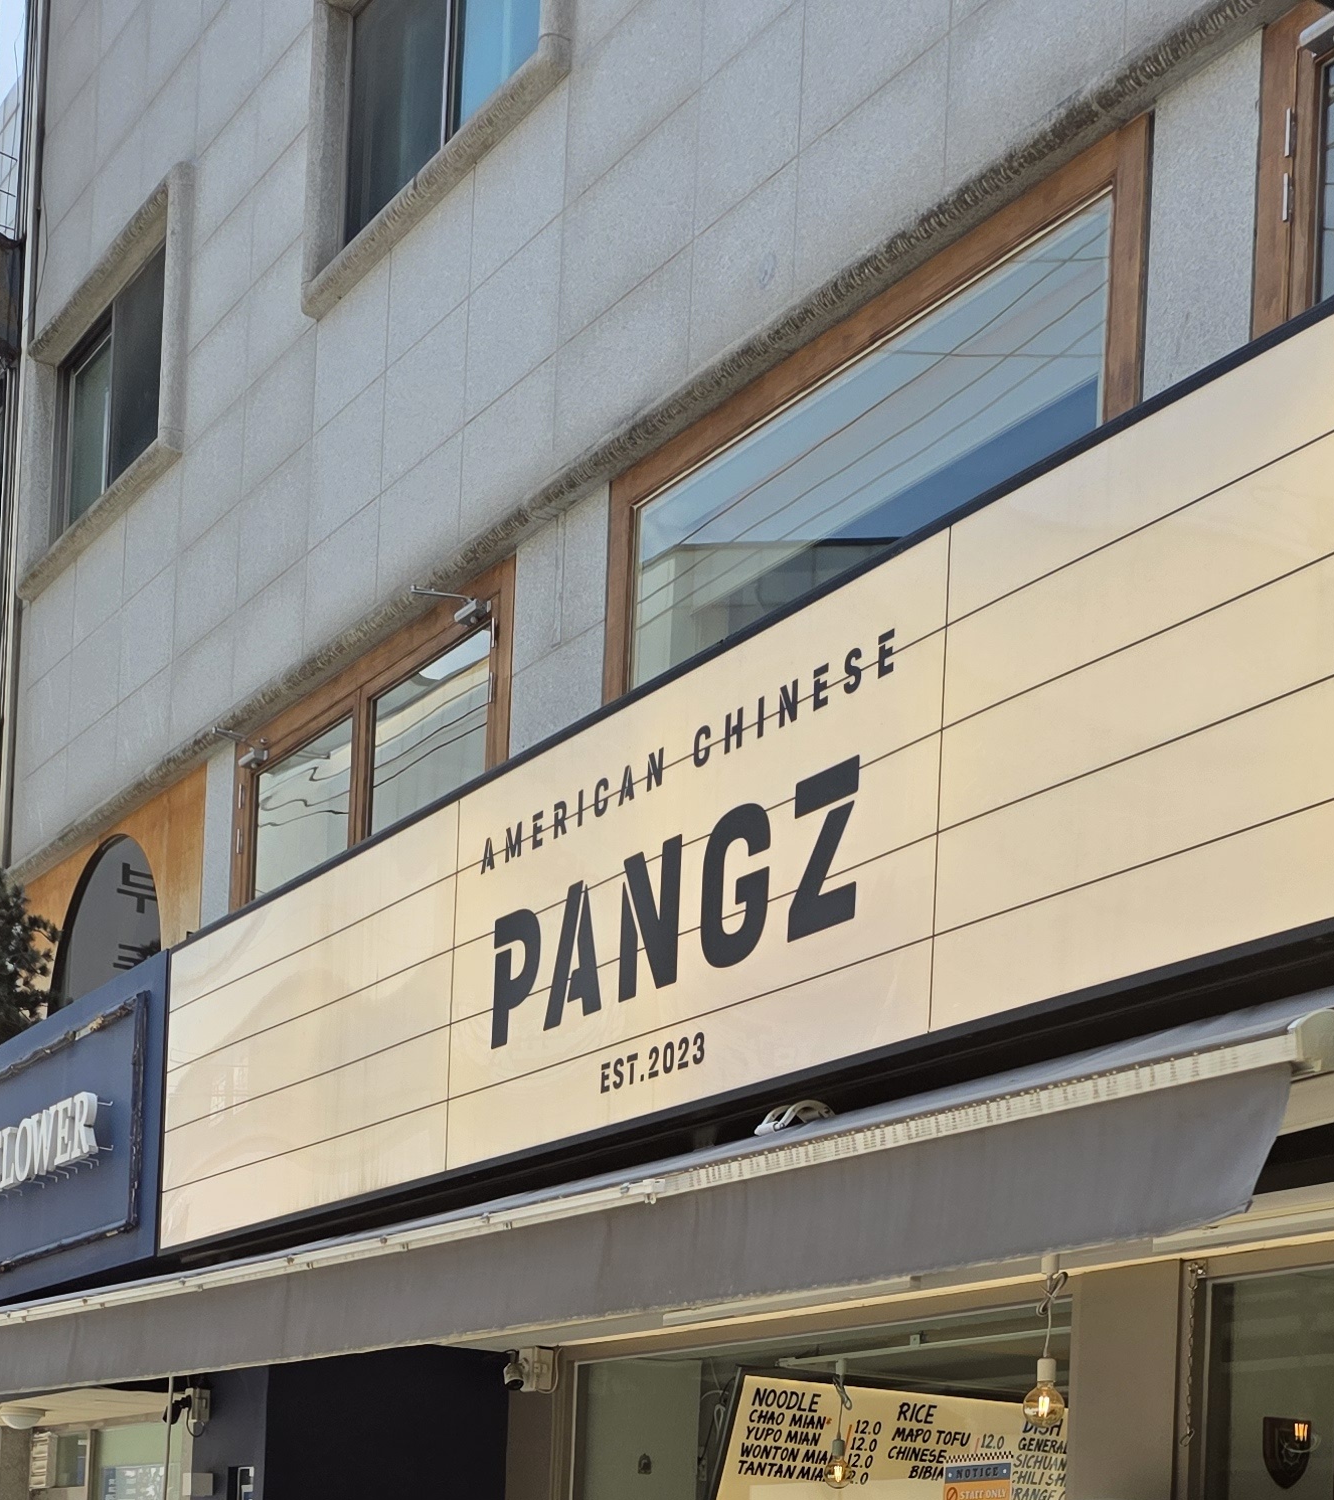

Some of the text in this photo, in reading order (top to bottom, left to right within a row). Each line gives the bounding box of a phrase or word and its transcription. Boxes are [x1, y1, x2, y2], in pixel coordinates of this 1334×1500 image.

[480, 627, 896, 875] AMERICAN CHINESE
[490, 754, 861, 1050] PANGZ
[599, 1031, 707, 1094] EST.2023
[751, 1387, 821, 1413] NOODLE
[749, 1409, 785, 1426] CHAO
[854, 1419, 882, 1435] 12.0
[897, 1402, 938, 1424] RICE
[746, 1425, 878, 1453] YUPO MIAN 12.0
[891, 1427, 1005, 1450] MAPO TOFU 12.0
[740, 1442, 800, 1463] WONTON
[847, 1453, 874, 1469] 12.0
[888, 1445, 947, 1464] CHINESE
[1013, 1453, 1067, 1472] SICHUAN
[738, 1460, 796, 1479] TANTAN
[956, 1466, 999, 1479] NOTICE
[986, 1487, 1006, 1499] ONLY
